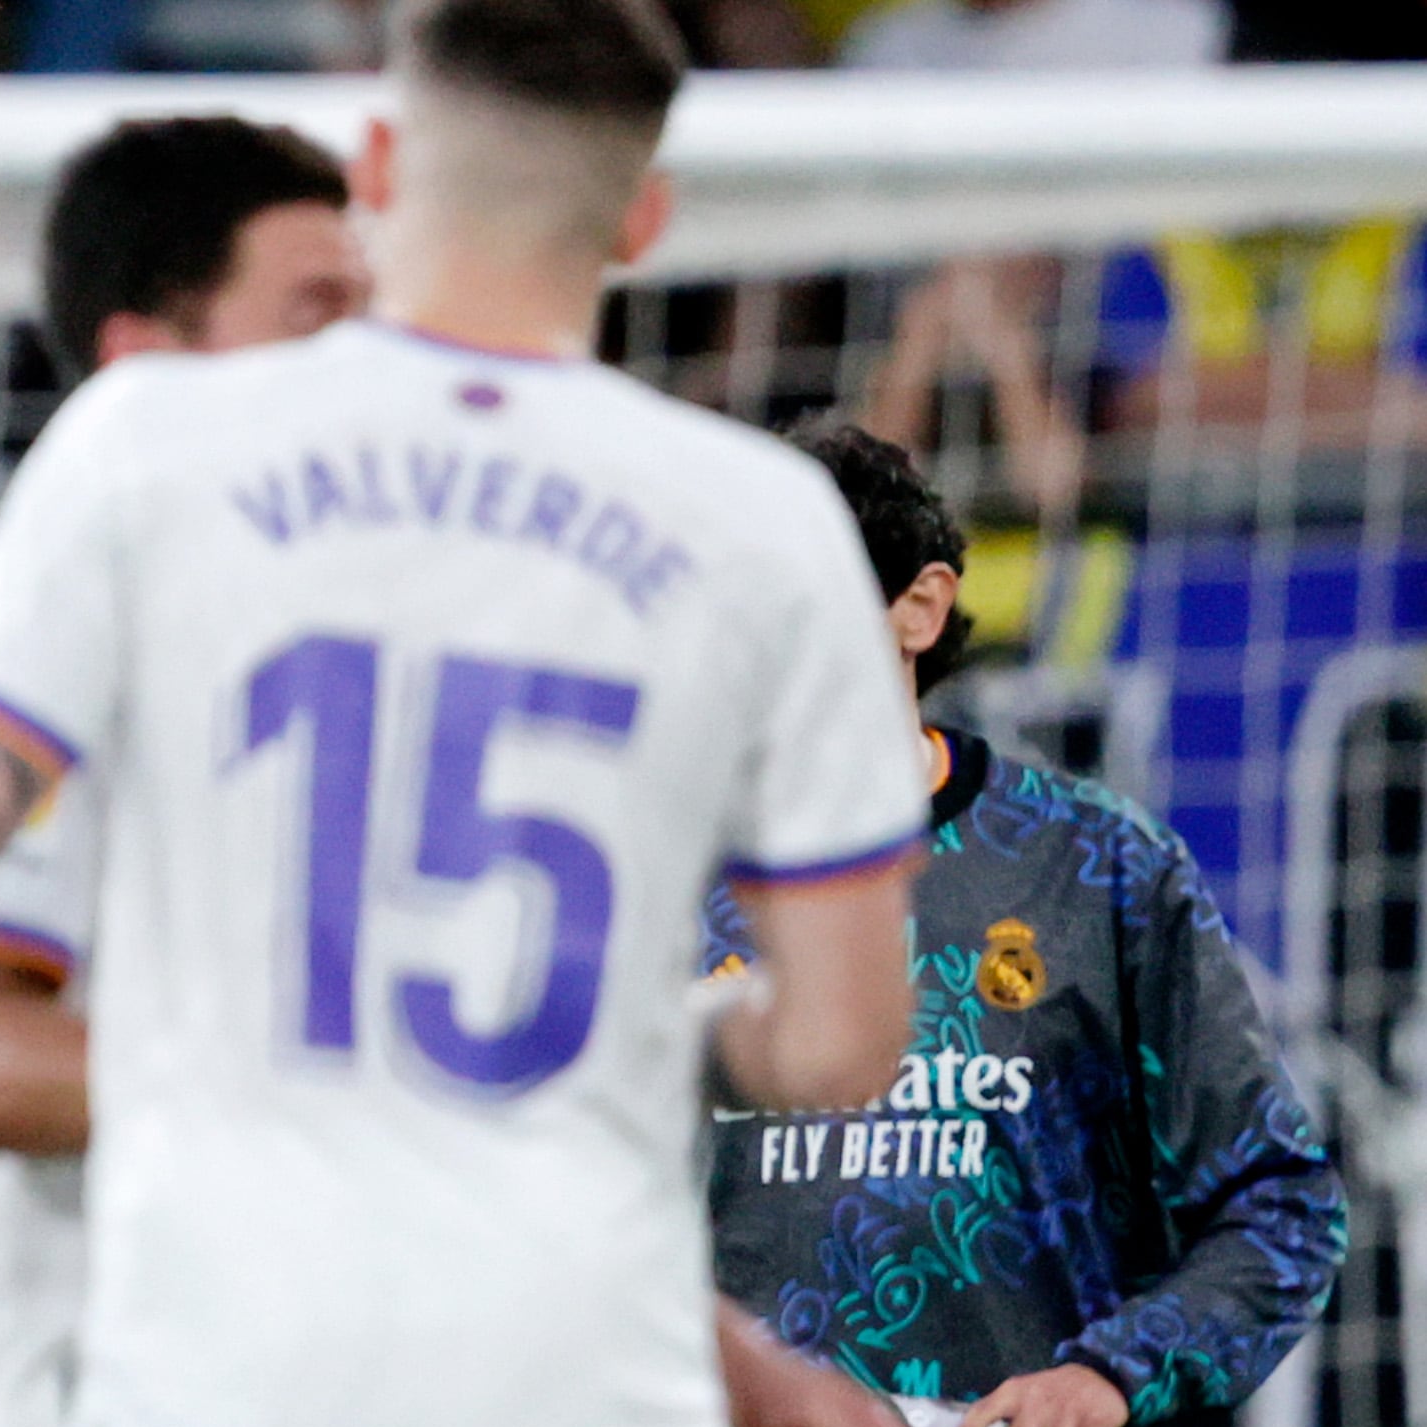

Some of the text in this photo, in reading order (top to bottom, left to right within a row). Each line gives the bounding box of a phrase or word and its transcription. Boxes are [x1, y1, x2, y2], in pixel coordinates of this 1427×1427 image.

[233, 442, 697, 614] VALVERDE
[225, 632, 641, 1090] 15
[759, 1117, 988, 1185] FLY BETTER
